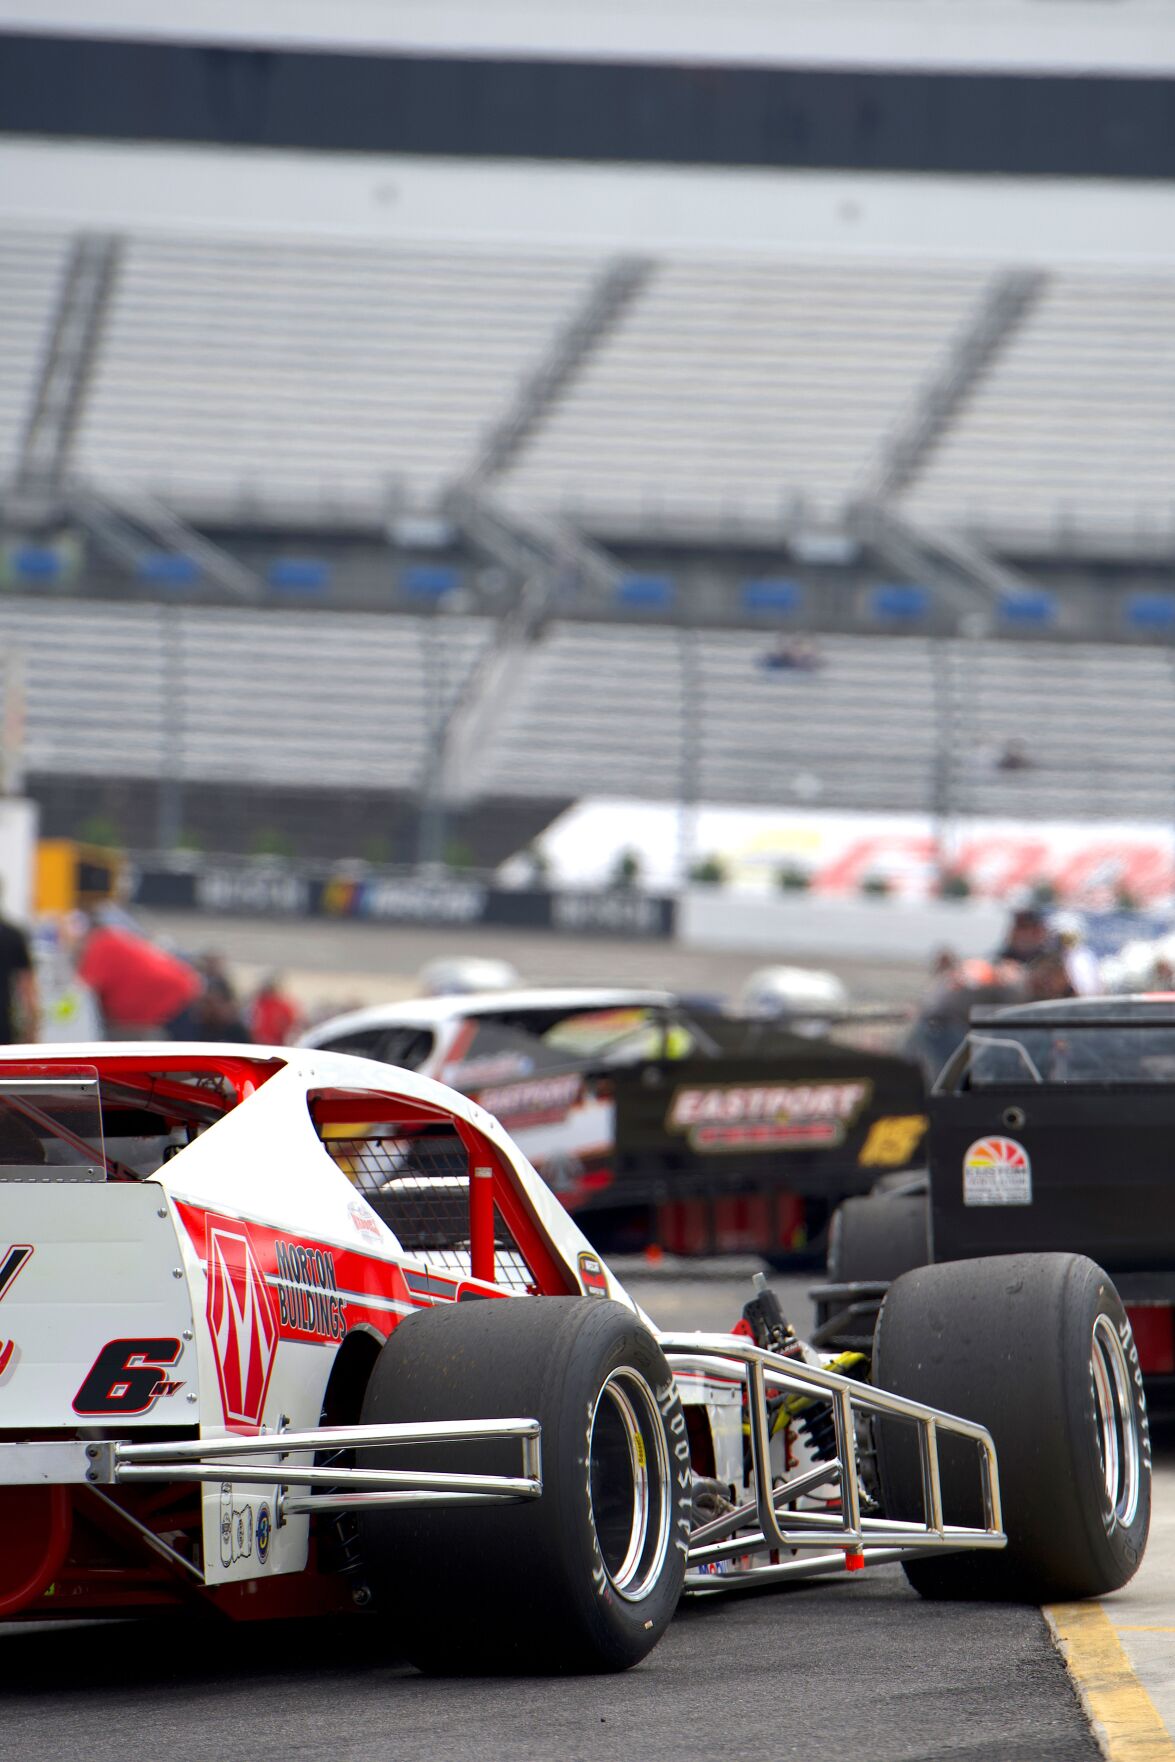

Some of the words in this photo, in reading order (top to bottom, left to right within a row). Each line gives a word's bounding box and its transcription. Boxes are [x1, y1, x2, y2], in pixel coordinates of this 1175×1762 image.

[674, 1084, 866, 1125] EASTPORT
[274, 1239, 338, 1292] MORTON
[277, 1282, 348, 1339] BUILDINGS
[71, 1337, 185, 1418] 6
[148, 1380, 187, 1397] NY
